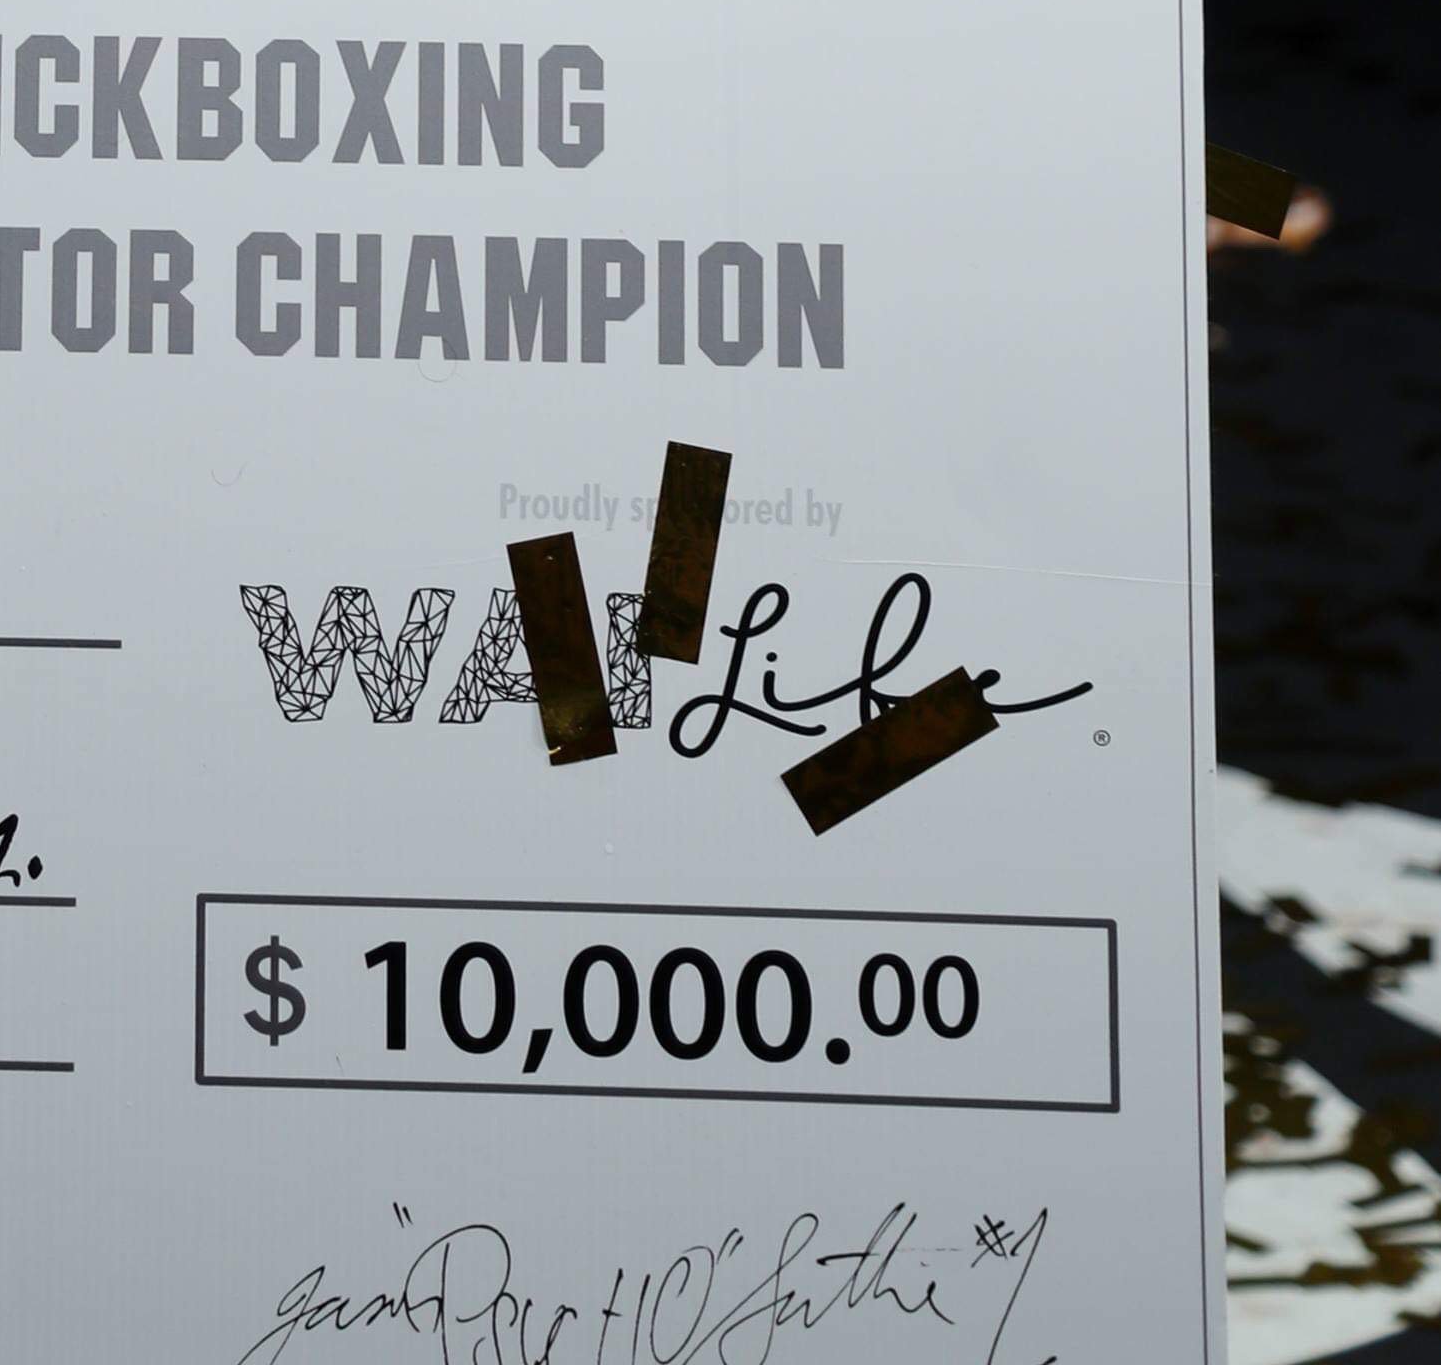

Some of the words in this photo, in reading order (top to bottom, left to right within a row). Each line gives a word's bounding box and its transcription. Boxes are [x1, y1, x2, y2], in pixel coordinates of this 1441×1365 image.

[235, 231, 845, 369] CHAMPION
[499, 483, 619, 531] Proudly
[630, 488, 793, 532] spored
[806, 488, 843, 537] by
[243, 935, 307, 1046] $
